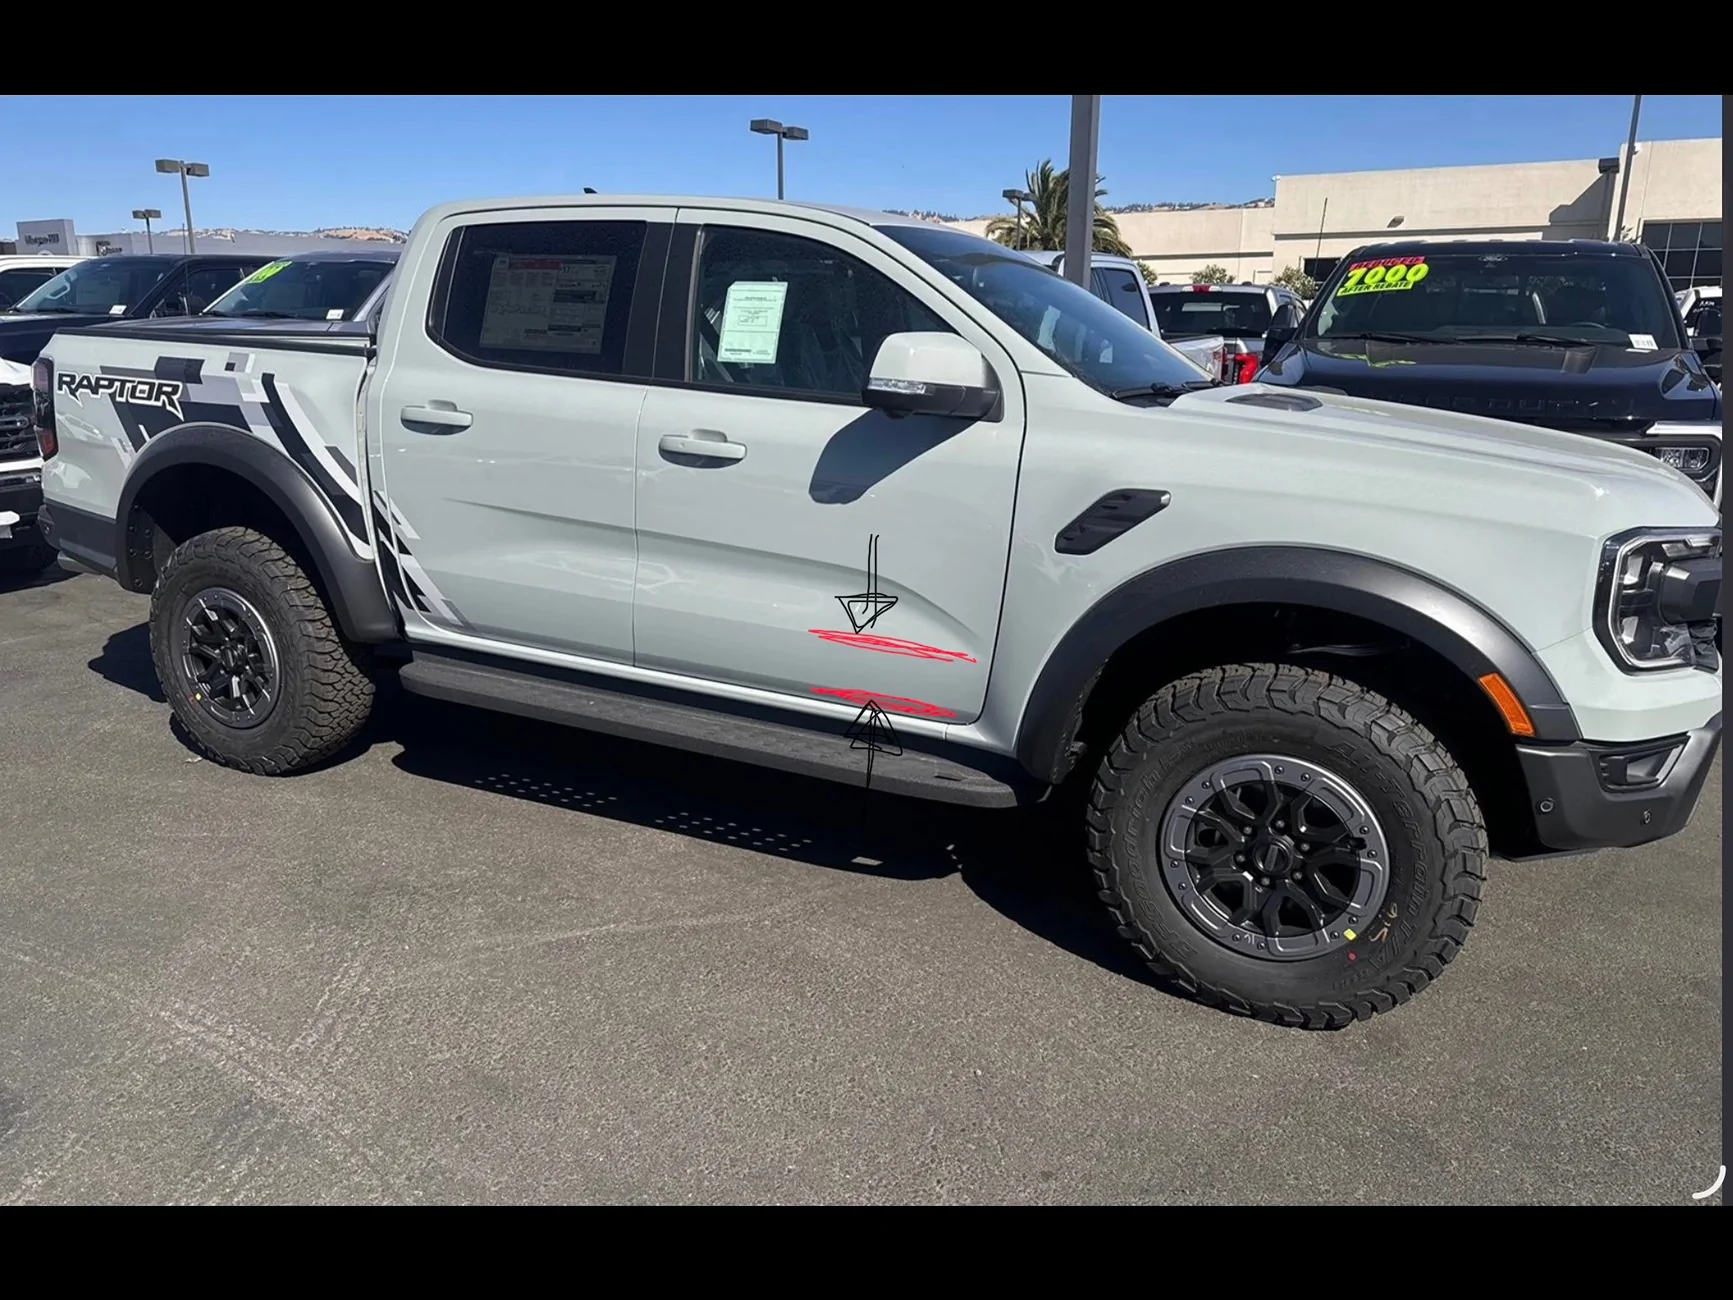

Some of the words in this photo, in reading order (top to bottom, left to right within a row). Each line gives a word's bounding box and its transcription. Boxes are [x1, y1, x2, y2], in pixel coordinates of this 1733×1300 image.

[1341, 284, 1371, 295] AFTER
[1372, 281, 1408, 290] REBATE
[56, 370, 185, 422] RAPTOR
